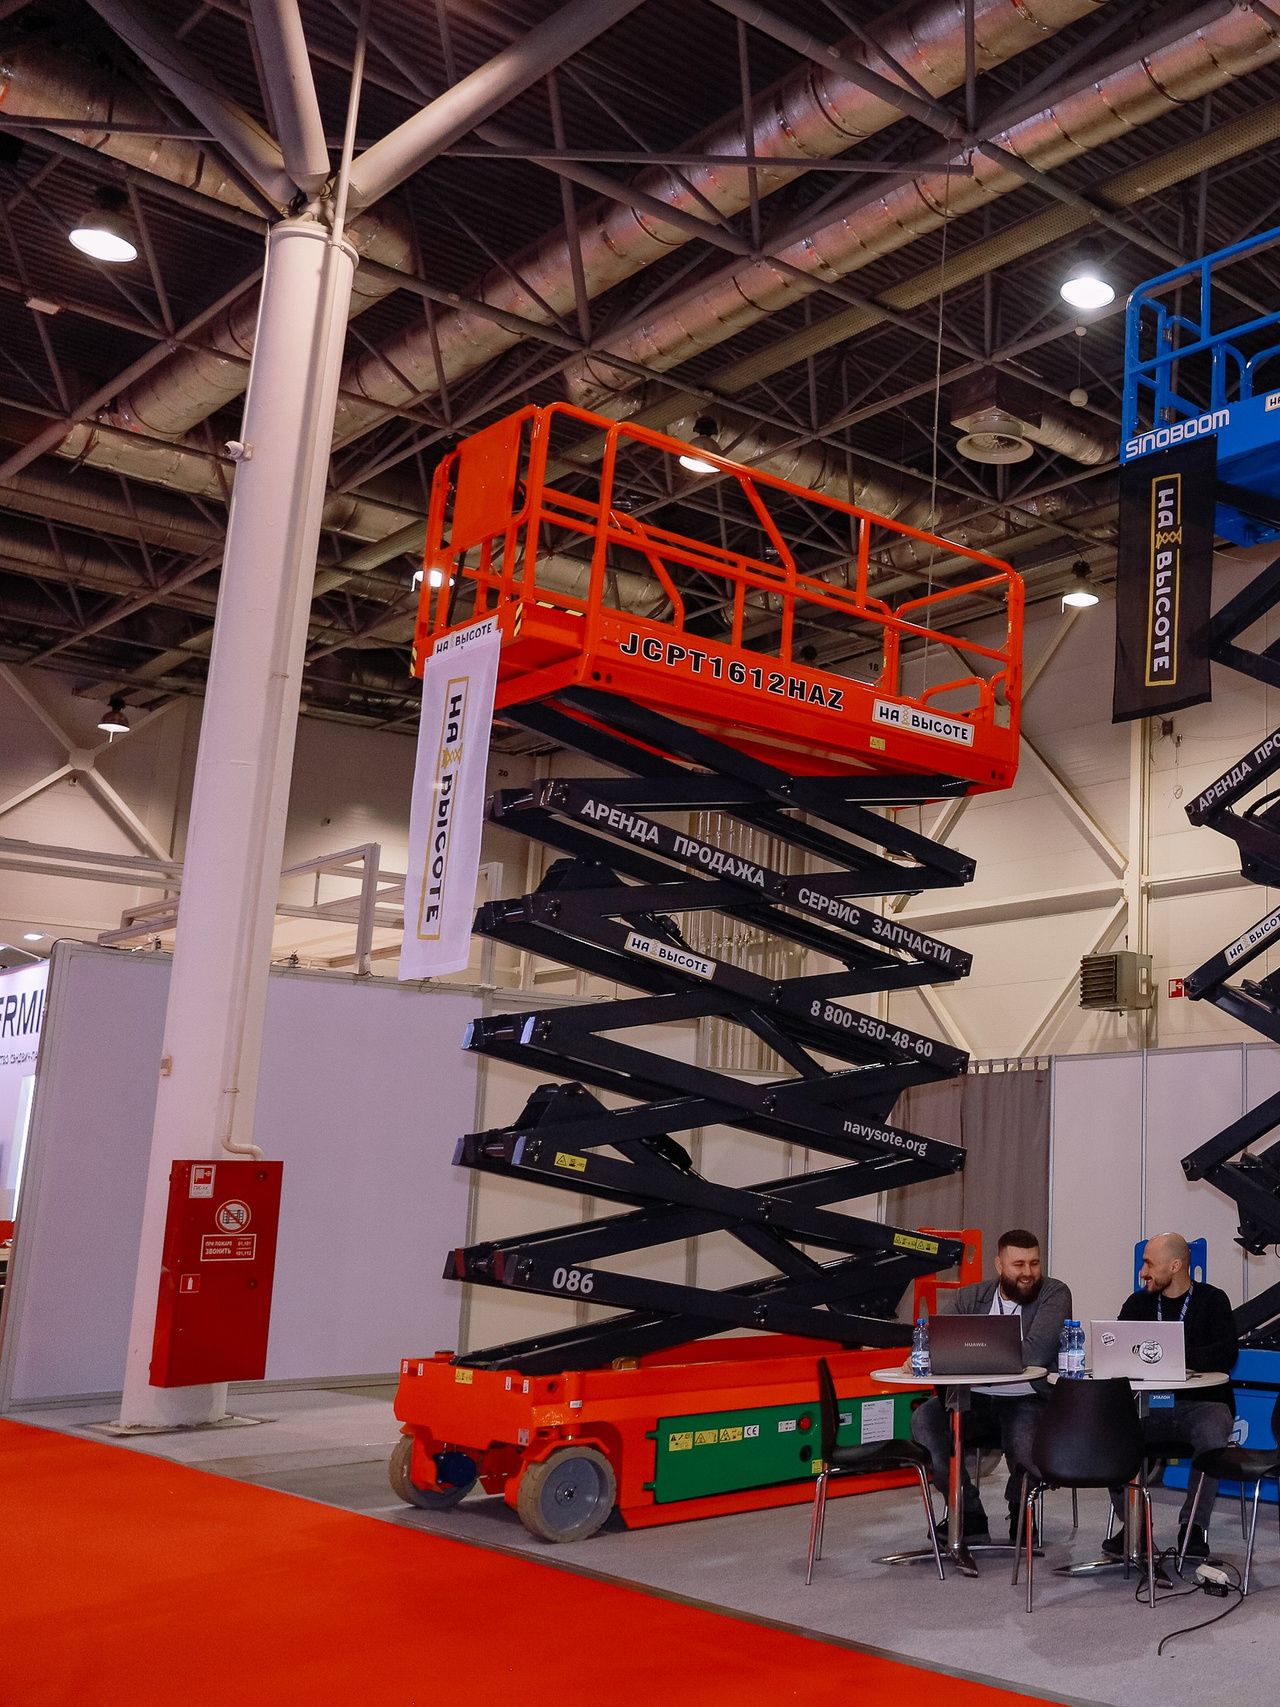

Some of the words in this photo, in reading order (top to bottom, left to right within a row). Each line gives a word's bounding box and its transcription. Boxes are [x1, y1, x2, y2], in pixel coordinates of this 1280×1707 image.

[1125, 409, 1230, 459] SINOBOOM
[1157, 487, 1174, 529] НА
[1153, 551, 1172, 672] ВЫСОТЕ
[436, 641, 449, 653] НА
[455, 623, 493, 646] ВЫСОТЕ
[619, 633, 844, 711] JCPT1612HAZ
[868, 662, 879, 672] 18
[446, 694, 462, 743] НА
[879, 705, 900, 722] НА
[911, 713, 969, 740] ВЫСОТЕ
[498, 769, 509, 777] 20
[1198, 762, 1253, 813] АРЕНДА
[580, 799, 660, 845] АРЕНДА
[673, 835, 766, 889] ПРОДАЖА
[797, 888, 861, 926] СЕРВИС
[871, 918, 953, 964] ЗАПЧАСТИ
[631, 937, 650, 953] НА
[658, 948, 708, 974] ВЫСОТЕ
[1228, 943, 1245, 959] НА
[810, 1000, 821, 1016] 8
[823, 1005, 933, 1058] 800-550-48-60
[843, 1120, 928, 1157] navysote.org
[552, 1267, 594, 1294] 086
